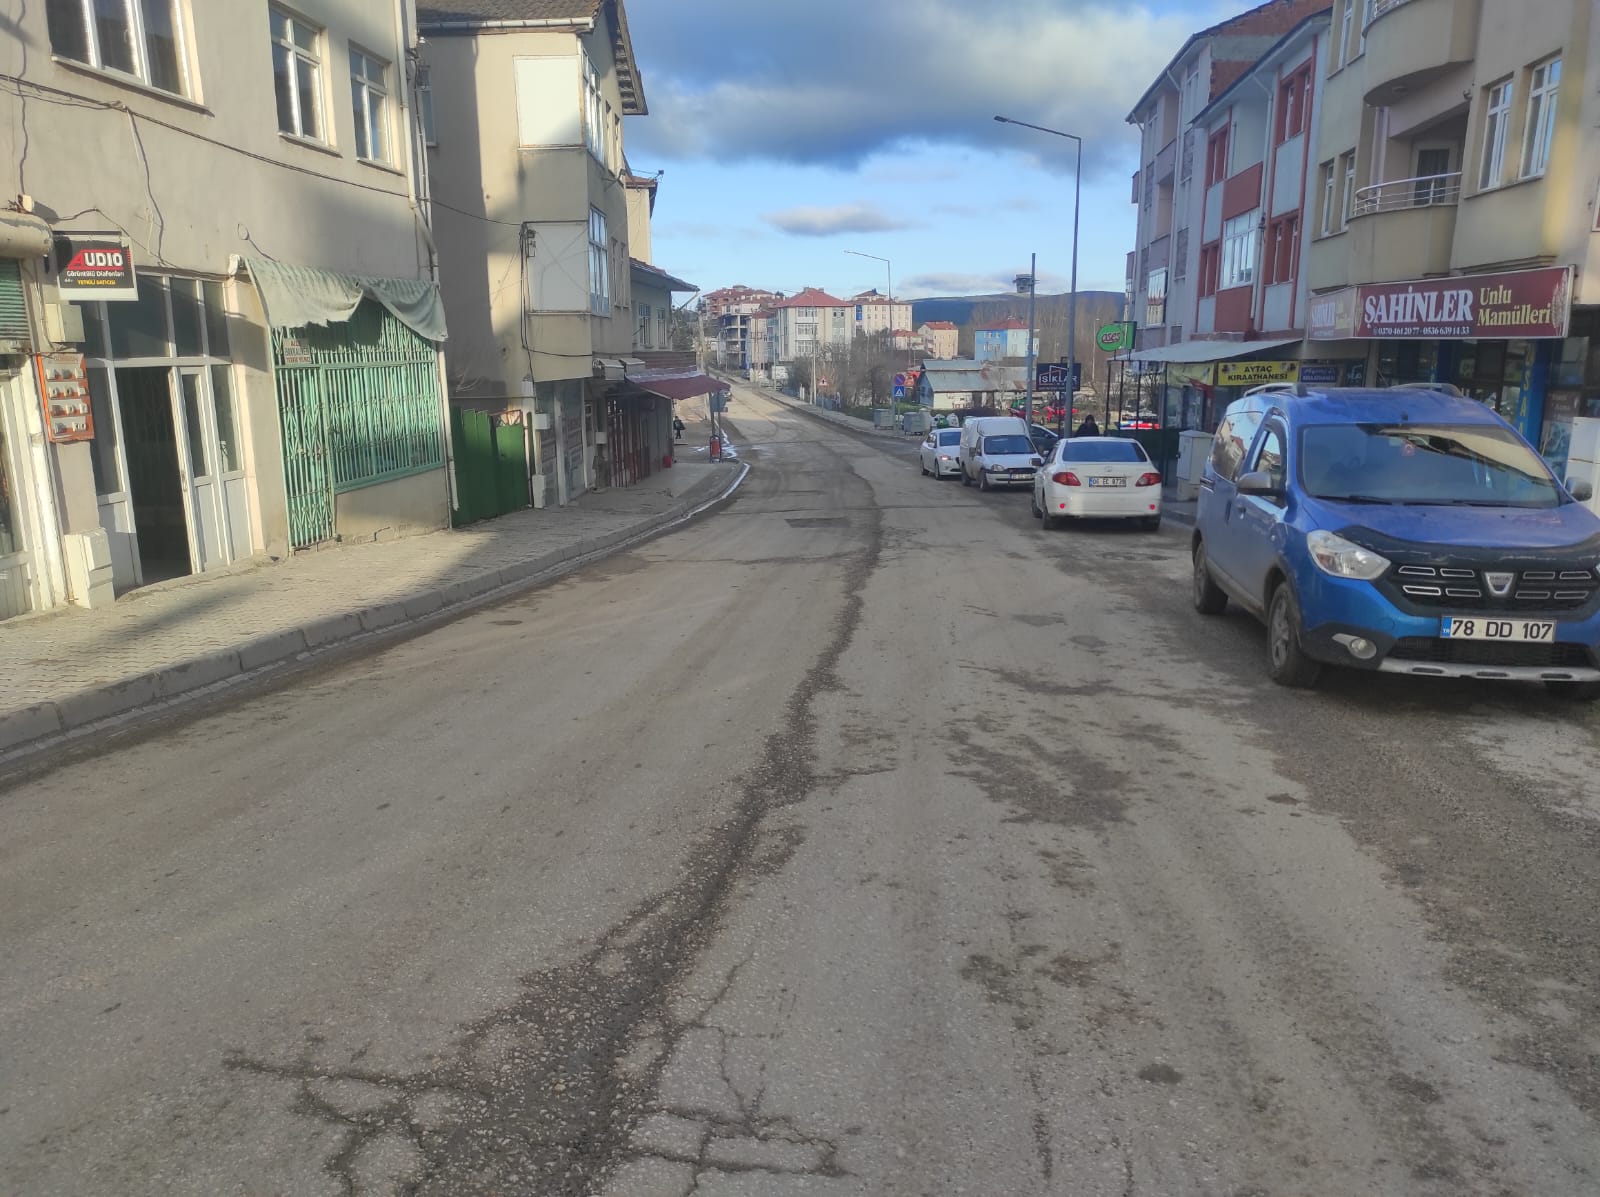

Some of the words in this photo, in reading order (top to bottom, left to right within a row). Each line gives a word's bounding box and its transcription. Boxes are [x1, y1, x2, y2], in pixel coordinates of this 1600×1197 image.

[67, 250, 123, 270] AUDIO
[1480, 285, 1512, 305] Unlu
[1365, 286, 1473, 328] ŞAHİNLER
[1477, 303, 1551, 326] Mamülleri
[1460, 326, 1470, 334] 33
[1228, 372, 1288, 381] KIRAATHANESİ
[1244, 365, 1272, 373] AYTAÇ
[1452, 620, 1474, 636] 78
[1486, 622, 1512, 637] DD
[1523, 623, 1552, 639] 107
